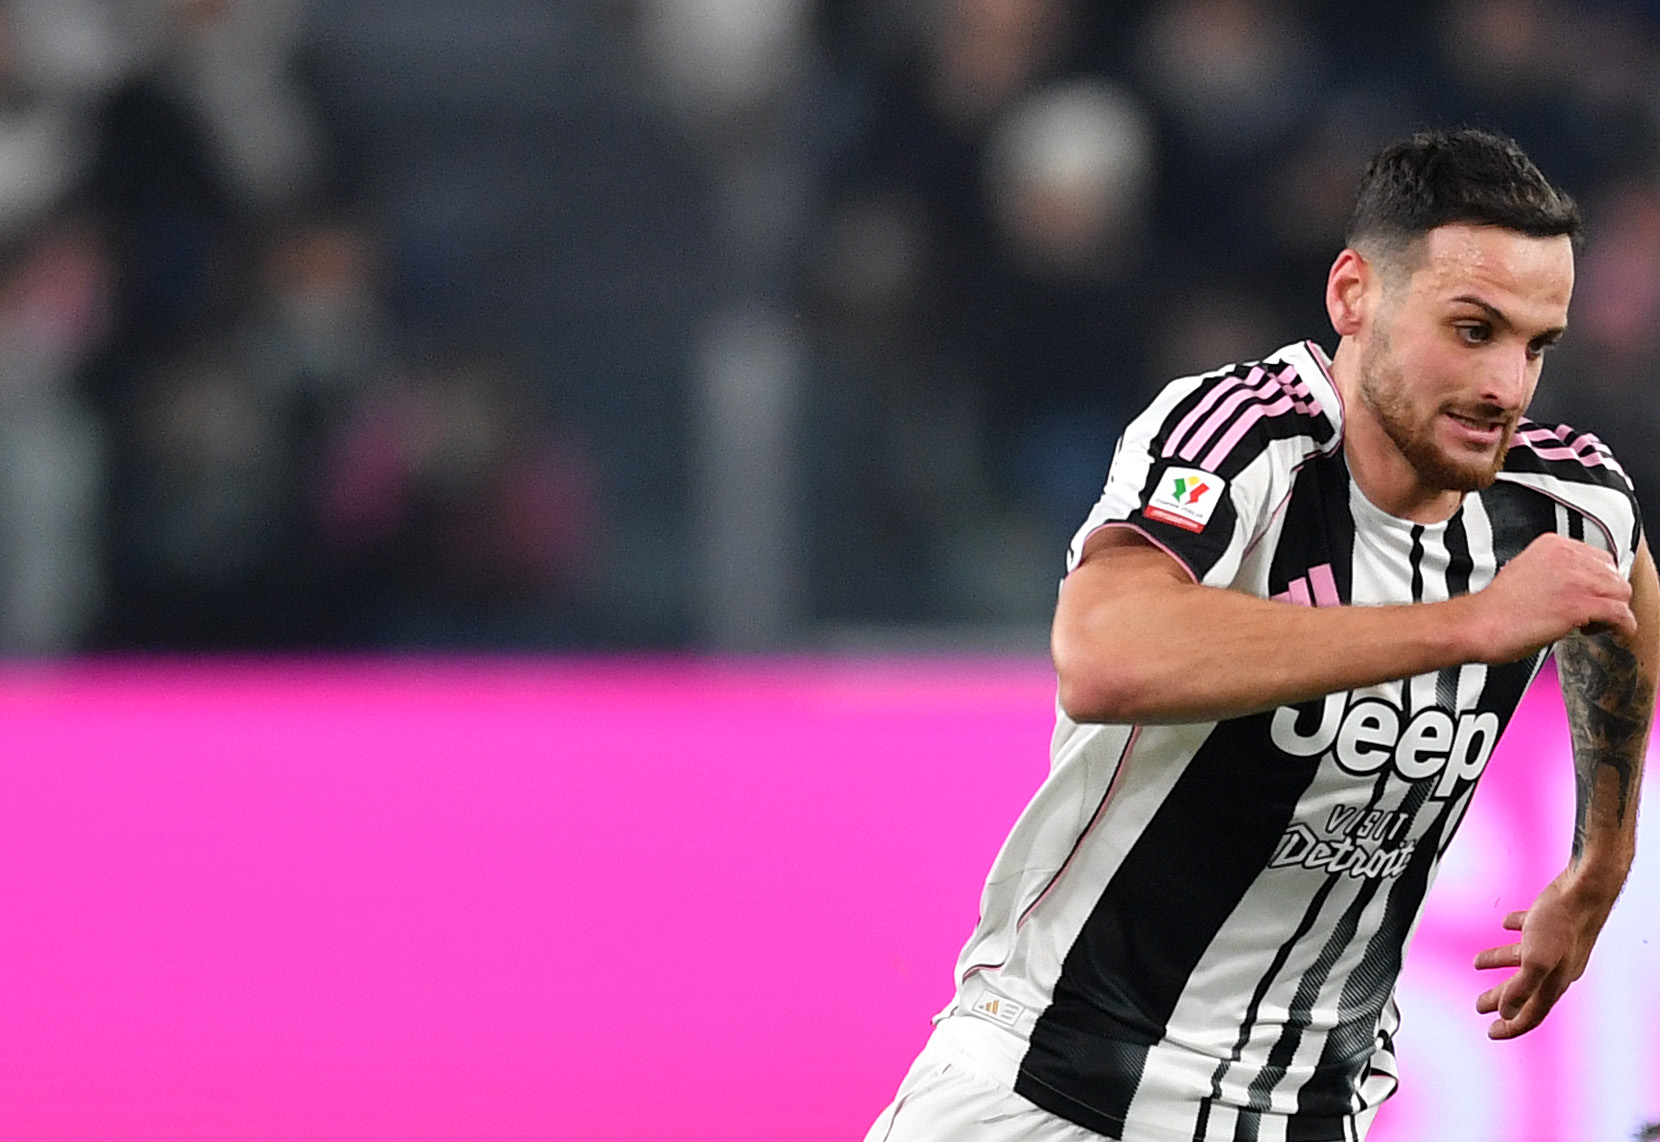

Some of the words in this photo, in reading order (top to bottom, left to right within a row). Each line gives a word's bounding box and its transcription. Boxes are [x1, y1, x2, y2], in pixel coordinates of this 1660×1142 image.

[1270, 690, 1499, 798] Jeep
[1268, 822, 1418, 879] Detroit
[1326, 804, 1409, 841] VISIT
